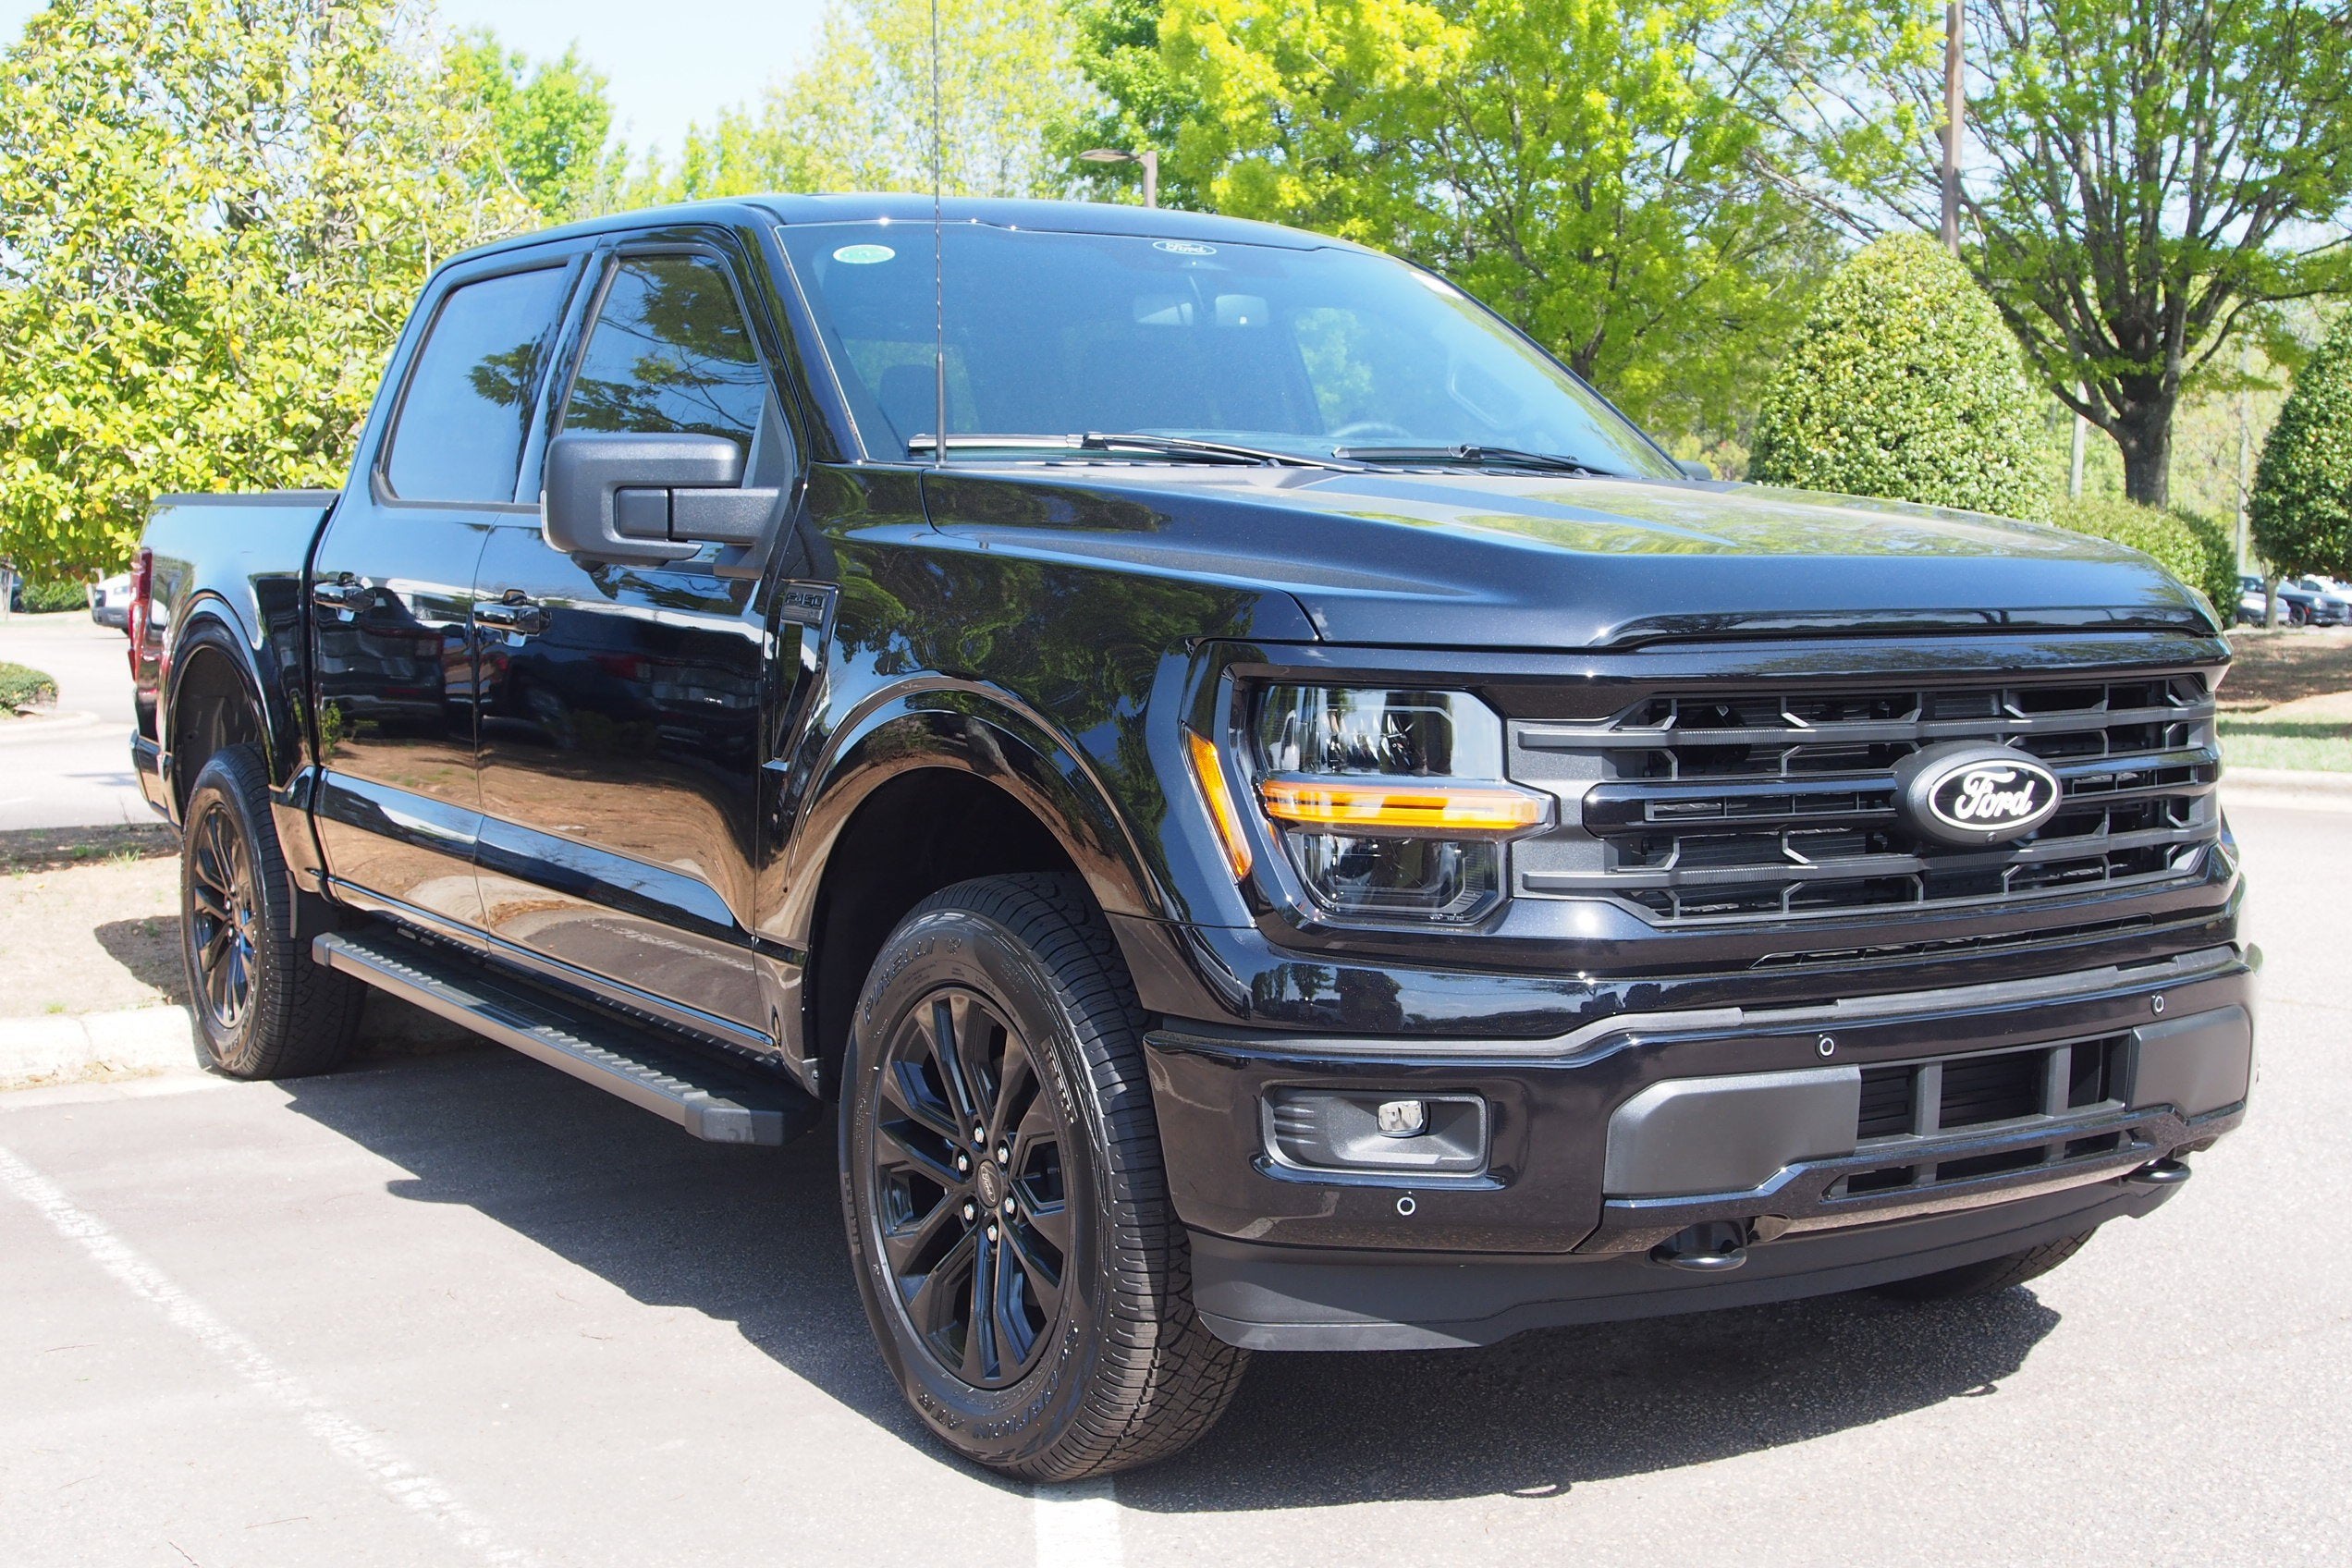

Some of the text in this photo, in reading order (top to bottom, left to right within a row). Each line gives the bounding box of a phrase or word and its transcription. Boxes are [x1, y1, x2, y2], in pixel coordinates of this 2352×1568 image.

[1166, 242, 1207, 253] Ford
[1954, 771, 2035, 819] Ford
[863, 936, 936, 1025] PIRELLI
